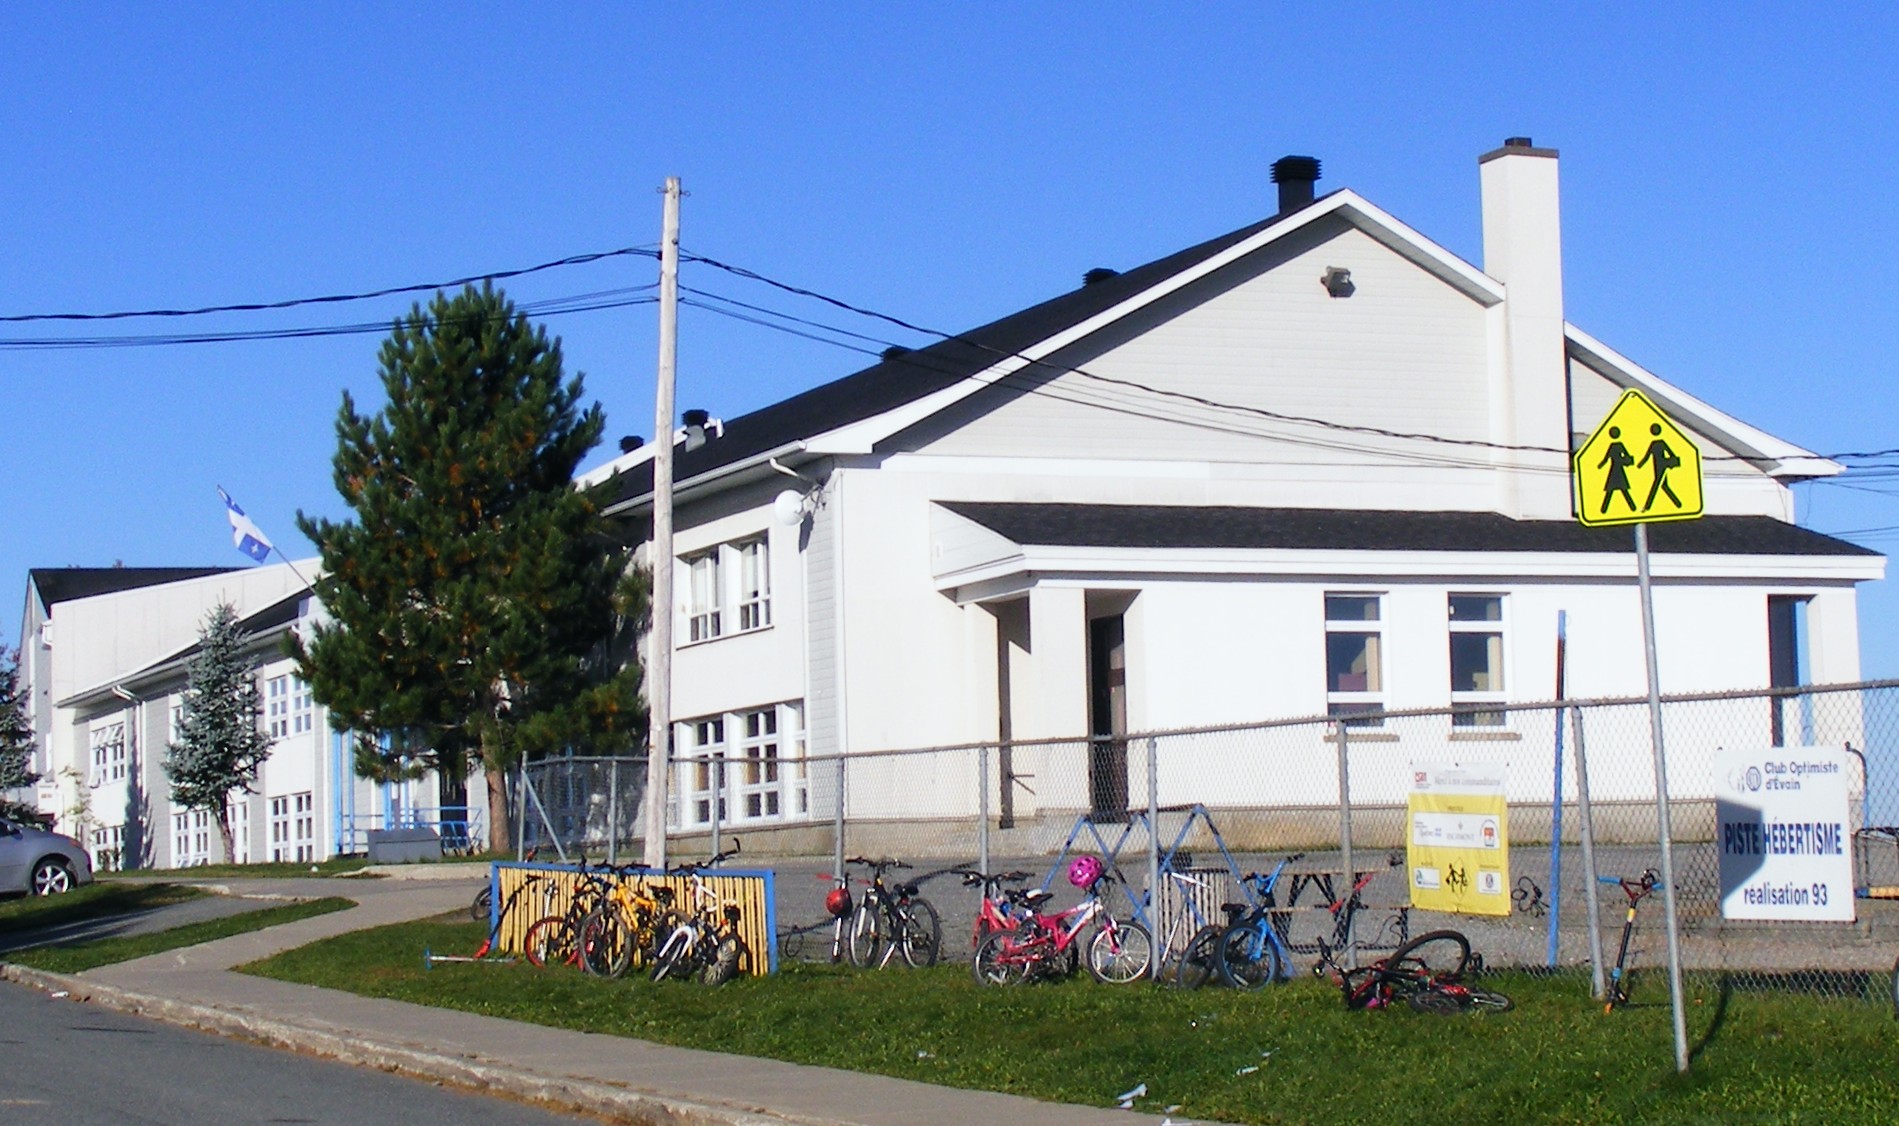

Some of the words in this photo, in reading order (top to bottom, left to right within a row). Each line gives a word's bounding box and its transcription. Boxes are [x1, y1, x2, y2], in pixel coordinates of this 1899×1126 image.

[1764, 762, 1787, 774] Club
[1790, 761, 1839, 776] Optimiste
[1766, 777, 1800, 790] d'Évain
[1724, 823, 1760, 855] PISTE
[1763, 818, 1842, 855] HÉBERTISME
[1743, 882, 1808, 905] réalisation
[1812, 883, 1828, 905] 93
